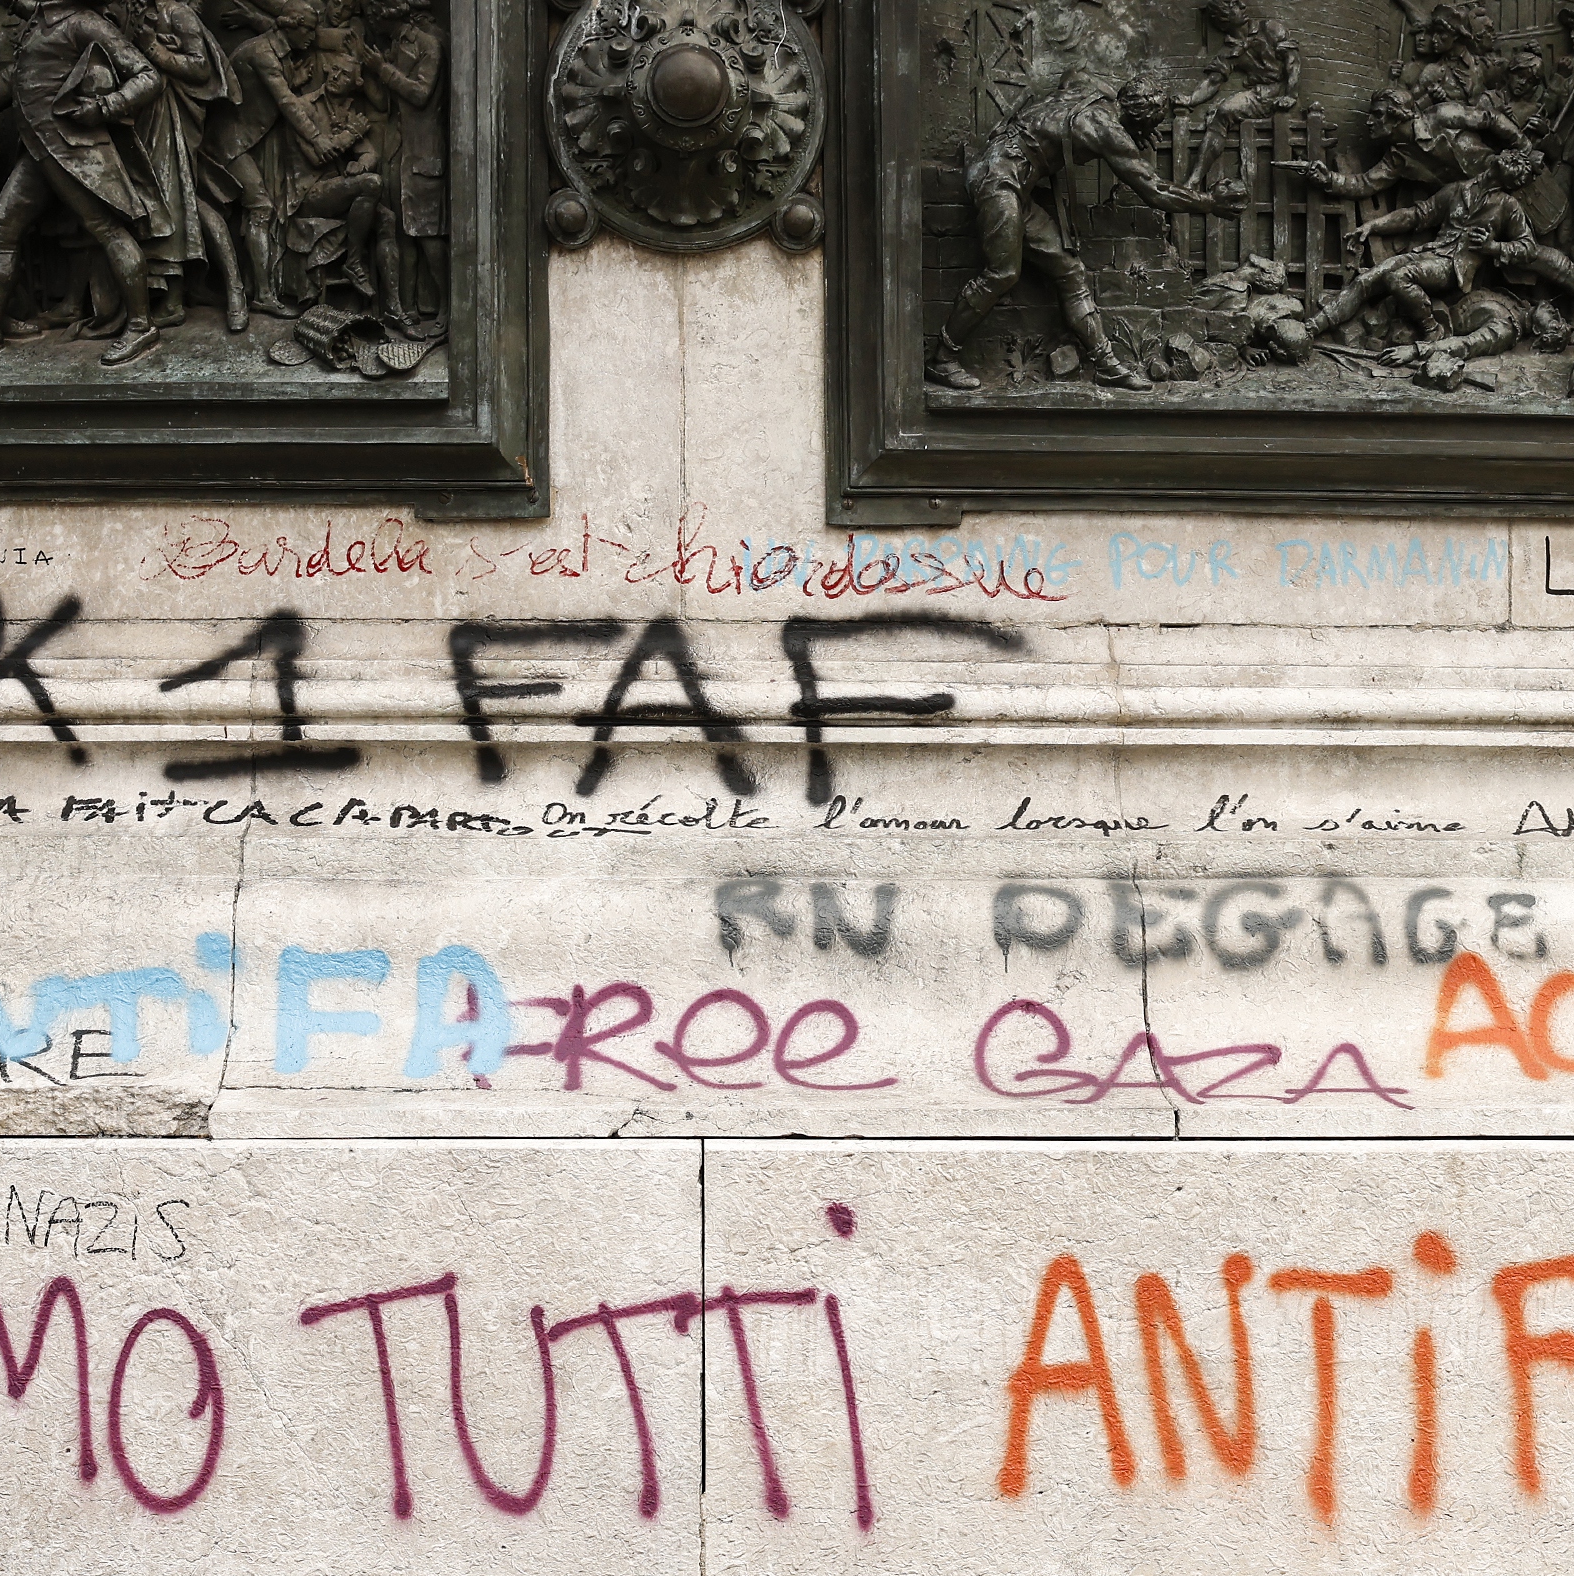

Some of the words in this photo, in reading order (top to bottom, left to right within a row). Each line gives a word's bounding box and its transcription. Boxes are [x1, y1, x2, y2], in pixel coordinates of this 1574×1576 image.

[1108, 532, 1238, 591] POUR
[159, 608, 361, 782] 1
[447, 608, 1025, 808] FAF
[541, 801, 586, 825] On
[605, 793, 779, 832] récolte
[814, 798, 970, 833] l'amour
[998, 797, 1171, 837] lorsque
[1202, 794, 1280, 833] l'on
[713, 878, 899, 966] RN
